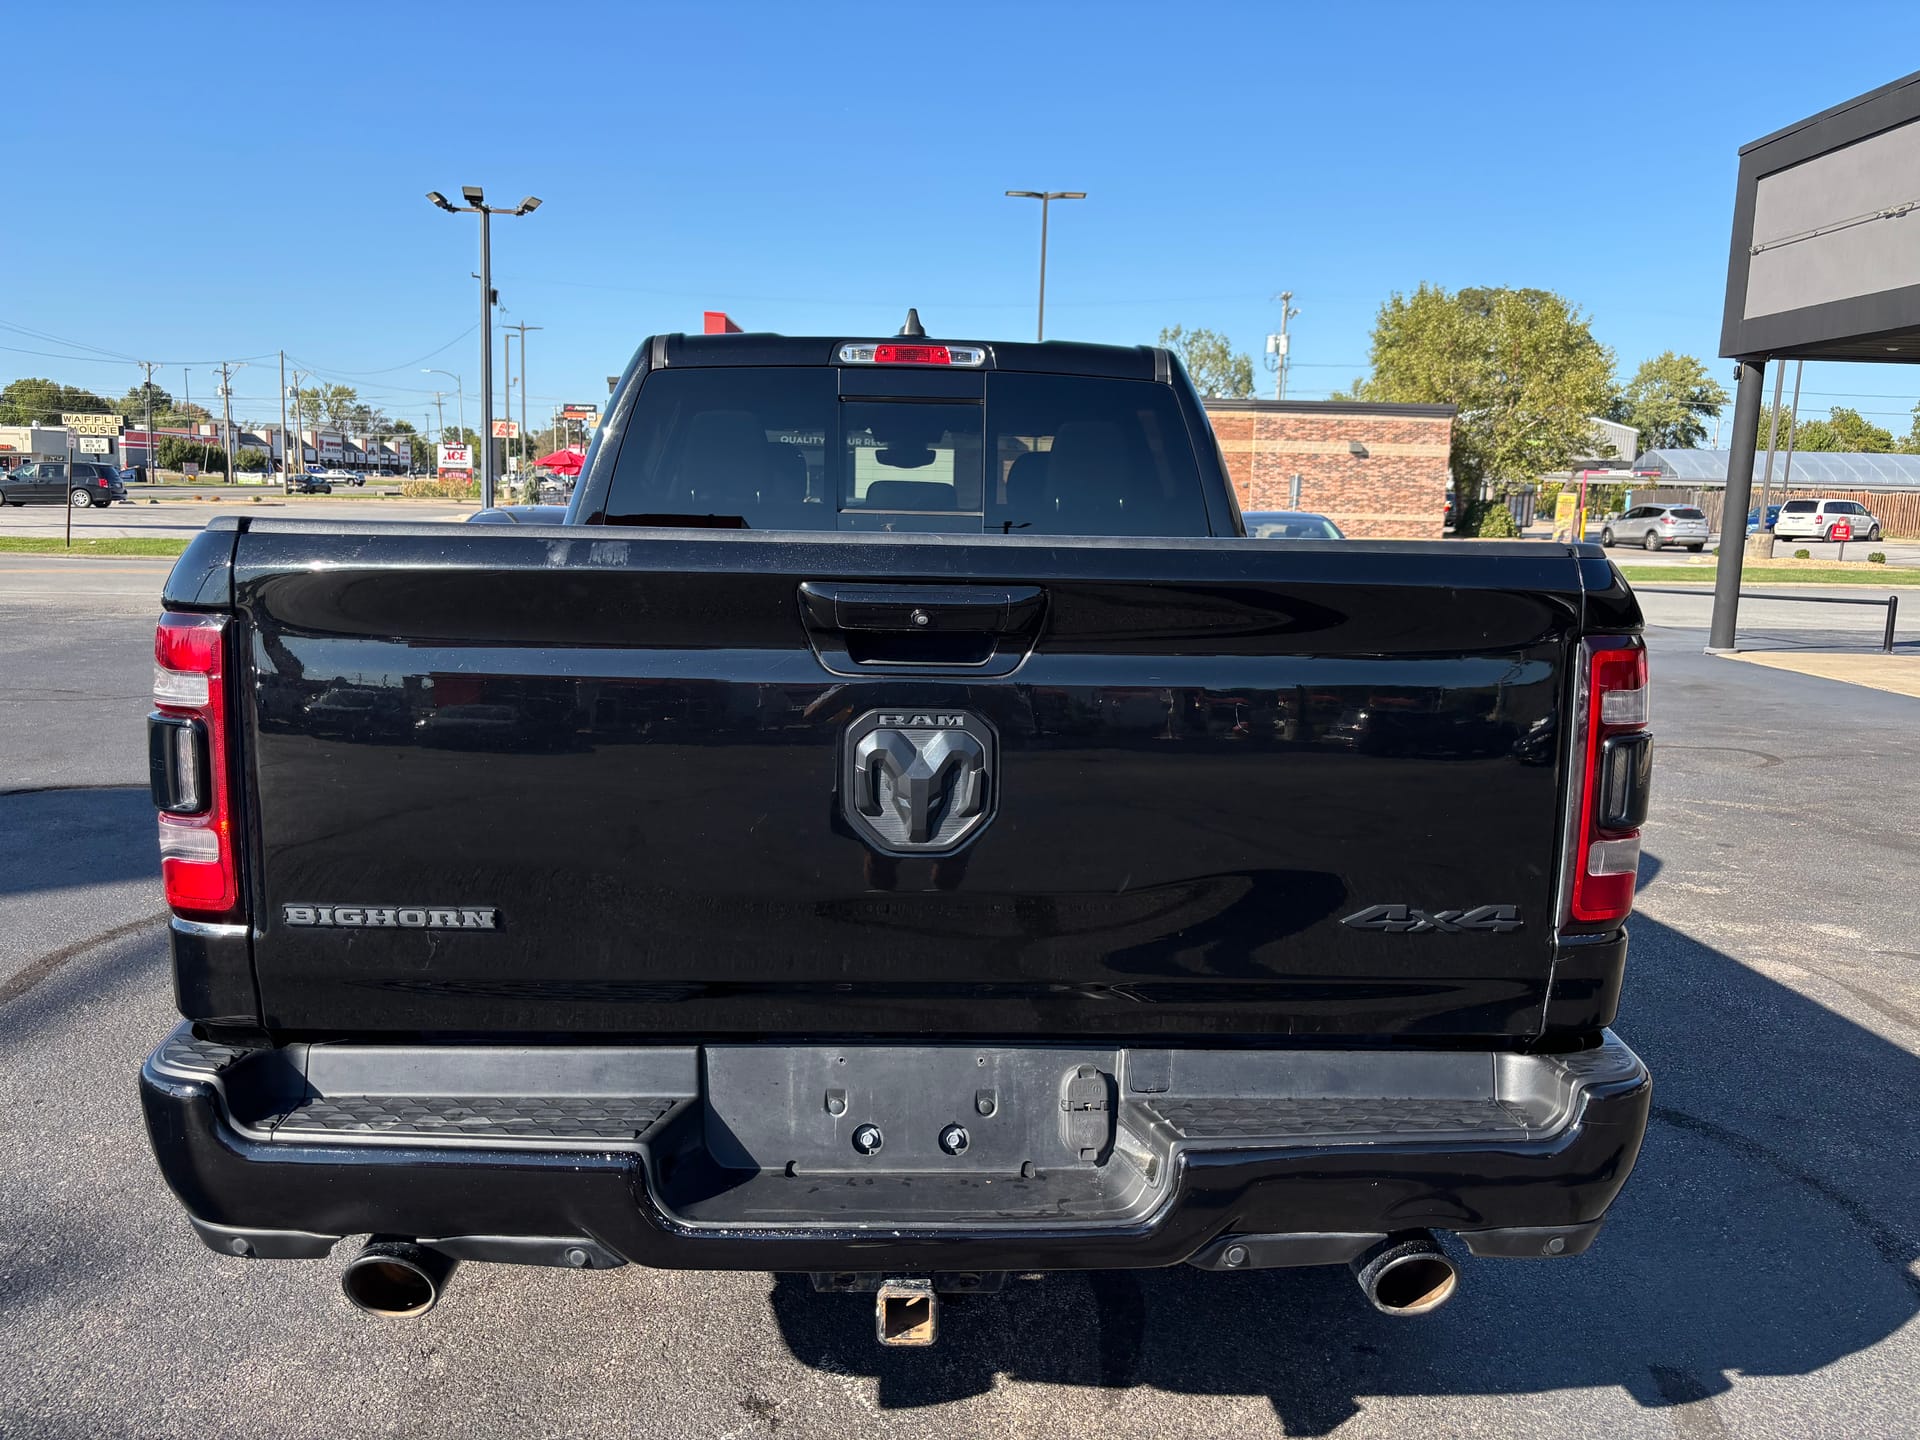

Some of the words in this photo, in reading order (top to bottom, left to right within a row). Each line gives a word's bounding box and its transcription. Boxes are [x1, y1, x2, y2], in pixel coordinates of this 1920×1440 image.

[63, 415, 121, 424] WAFFLE
[71, 425, 117, 434] OUSE
[780, 435, 825, 445] QUALITY
[847, 437, 861, 446] UR
[443, 451, 467, 461] ACE
[878, 714, 965, 727] RAM
[283, 904, 497, 929] BIGHORN
[1340, 904, 1524, 932] 4x4
